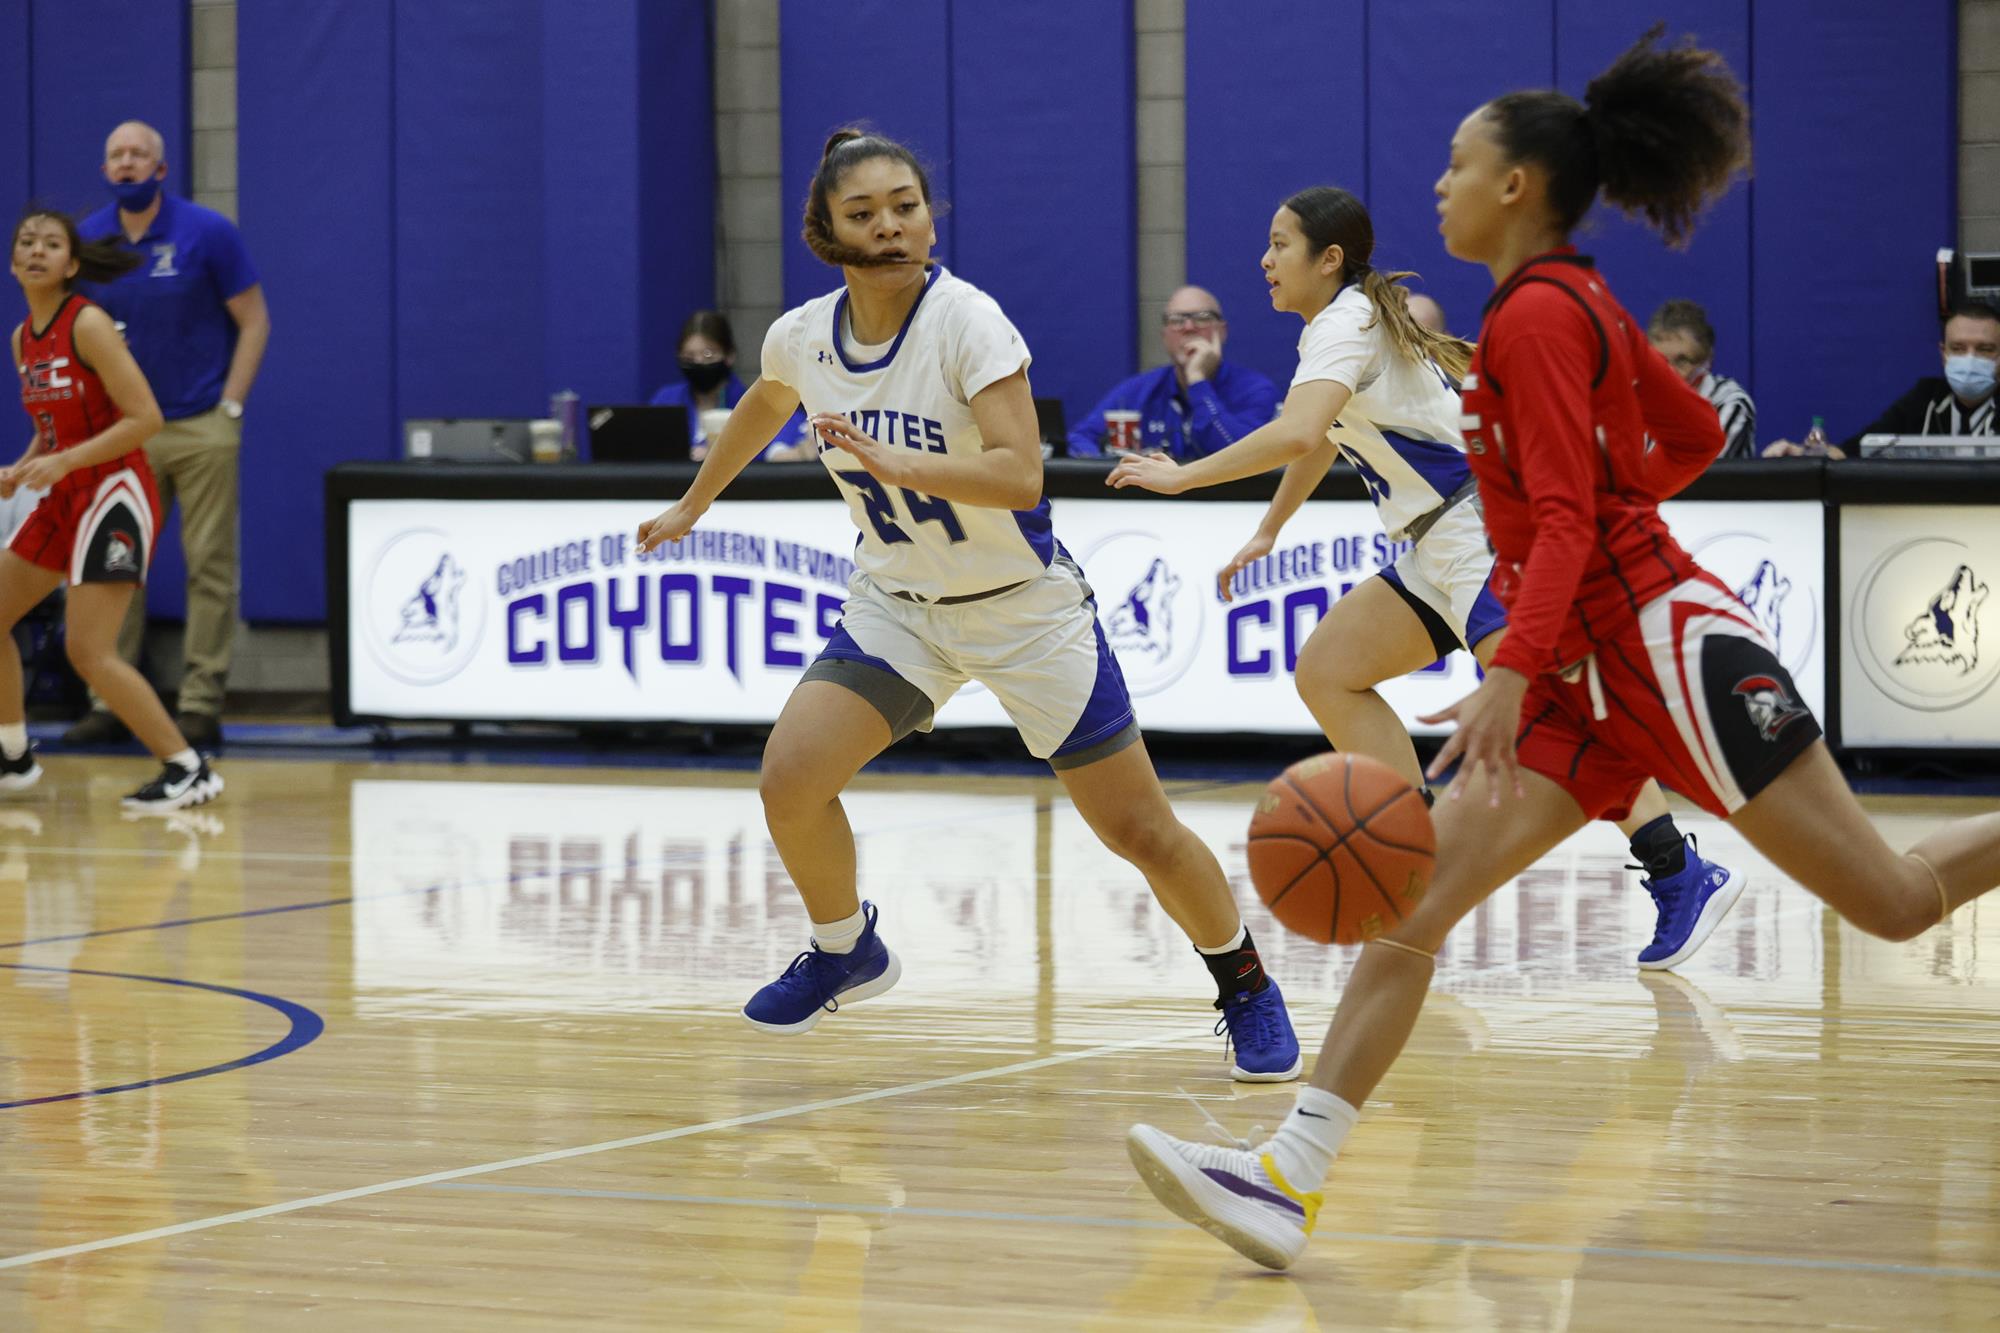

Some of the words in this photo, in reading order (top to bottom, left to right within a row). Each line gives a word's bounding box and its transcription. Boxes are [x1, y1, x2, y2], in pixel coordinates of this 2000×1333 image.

[812, 410, 948, 455] OTES
[834, 469, 968, 545] 24
[496, 539, 592, 596] COLLEGE
[600, 532, 627, 567] OF
[634, 529, 767, 569] OUTHERN
[774, 539, 857, 588] NEVAD
[1333, 535, 1365, 573] OF
